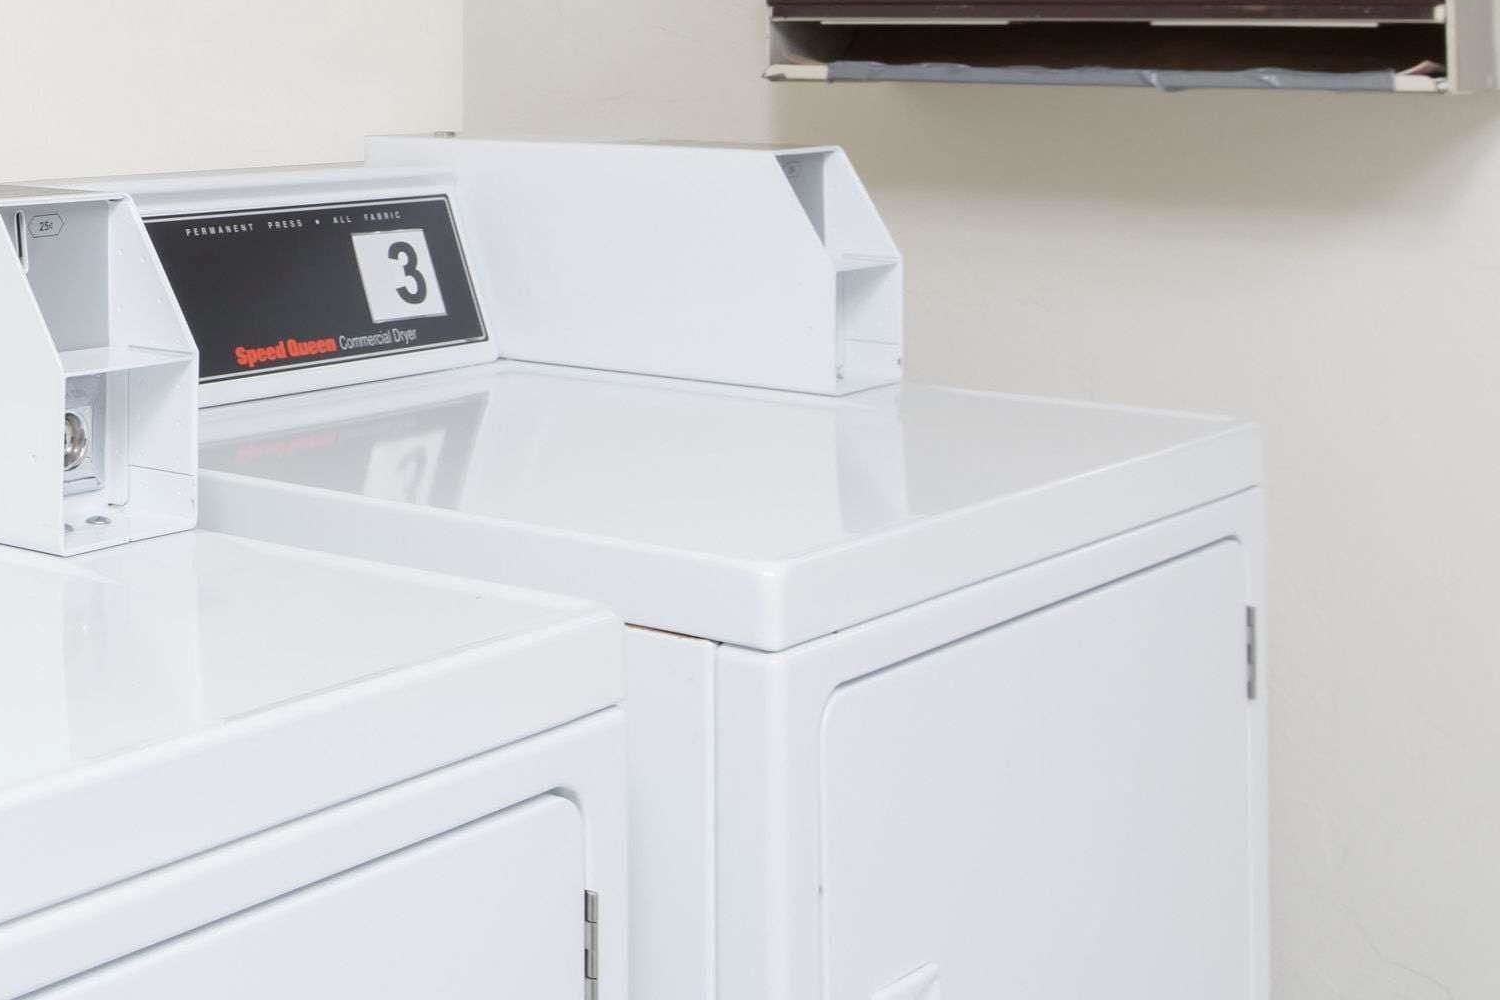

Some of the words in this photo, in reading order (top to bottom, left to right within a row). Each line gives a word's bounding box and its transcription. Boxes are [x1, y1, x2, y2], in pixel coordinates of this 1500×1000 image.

[184, 223, 253, 237] PERMANENT
[268, 219, 303, 230] PRESS
[332, 215, 352, 224] ALL
[364, 210, 401, 221] FABRIC
[387, 241, 428, 305] 3
[235, 341, 287, 367] Speed
[287, 337, 337, 357] Queen
[338, 331, 391, 350] Commercial
[392, 328, 417, 345] Dryer
